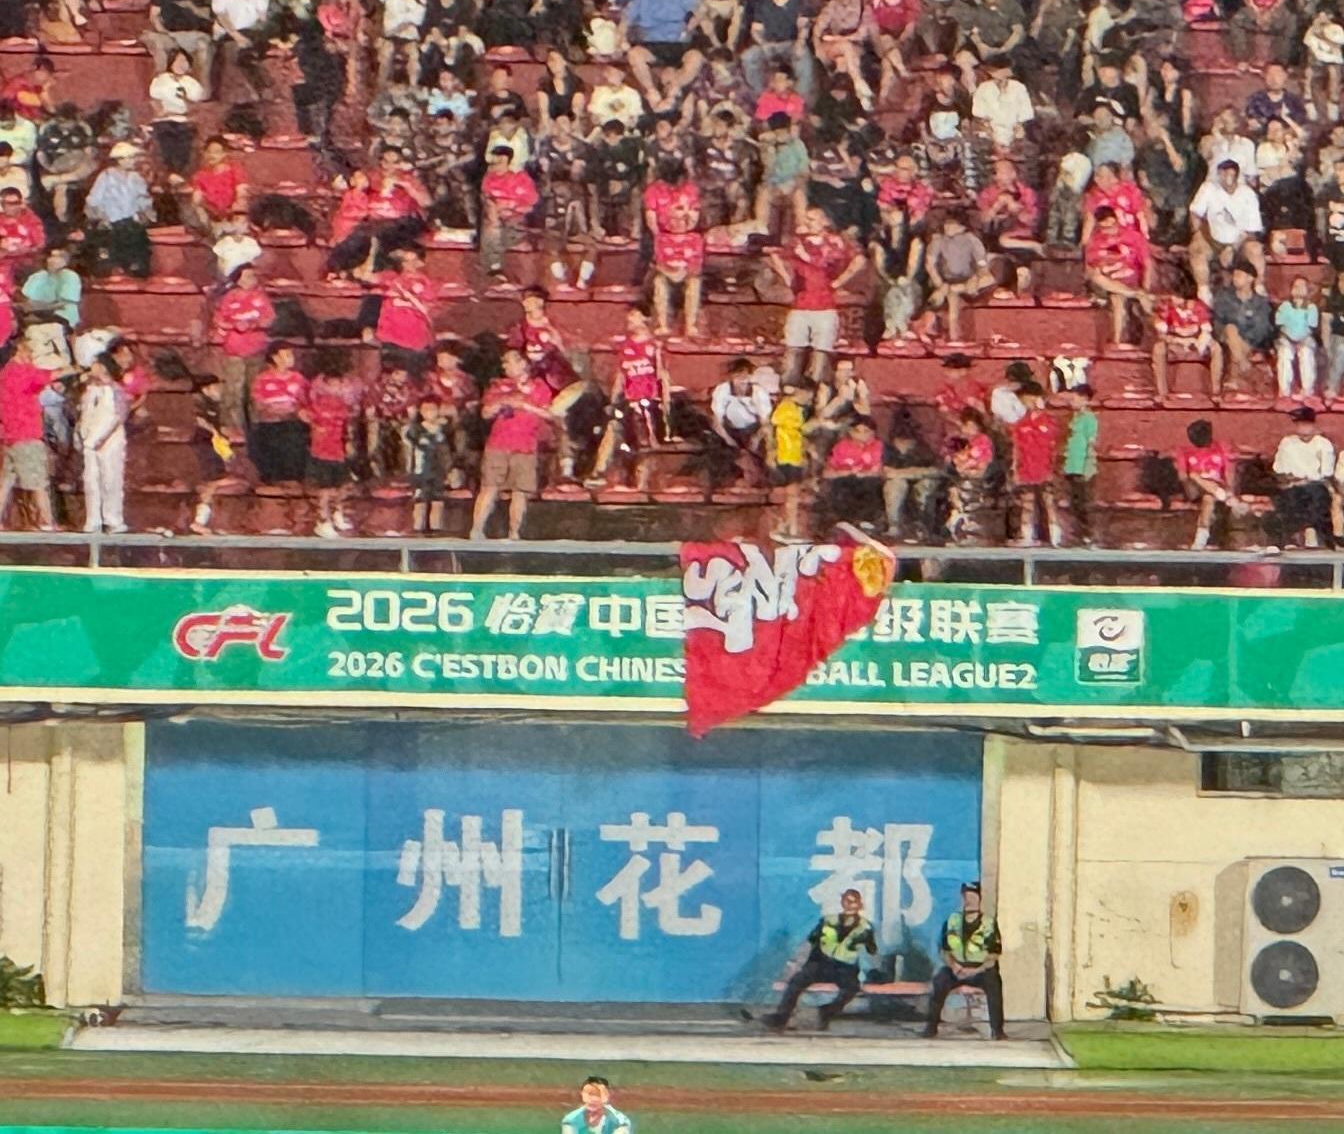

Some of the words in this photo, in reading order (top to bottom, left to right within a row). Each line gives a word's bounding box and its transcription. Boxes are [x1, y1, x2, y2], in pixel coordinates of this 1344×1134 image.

[326, 590, 475, 632] 2026
[327, 651, 404, 678] 2026
[412, 654, 568, 681] C'ESTBON
[575, 655, 686, 684] CHINES
[892, 661, 1038, 690] LEAGUE2
[184, 807, 935, 945] 广州花都
